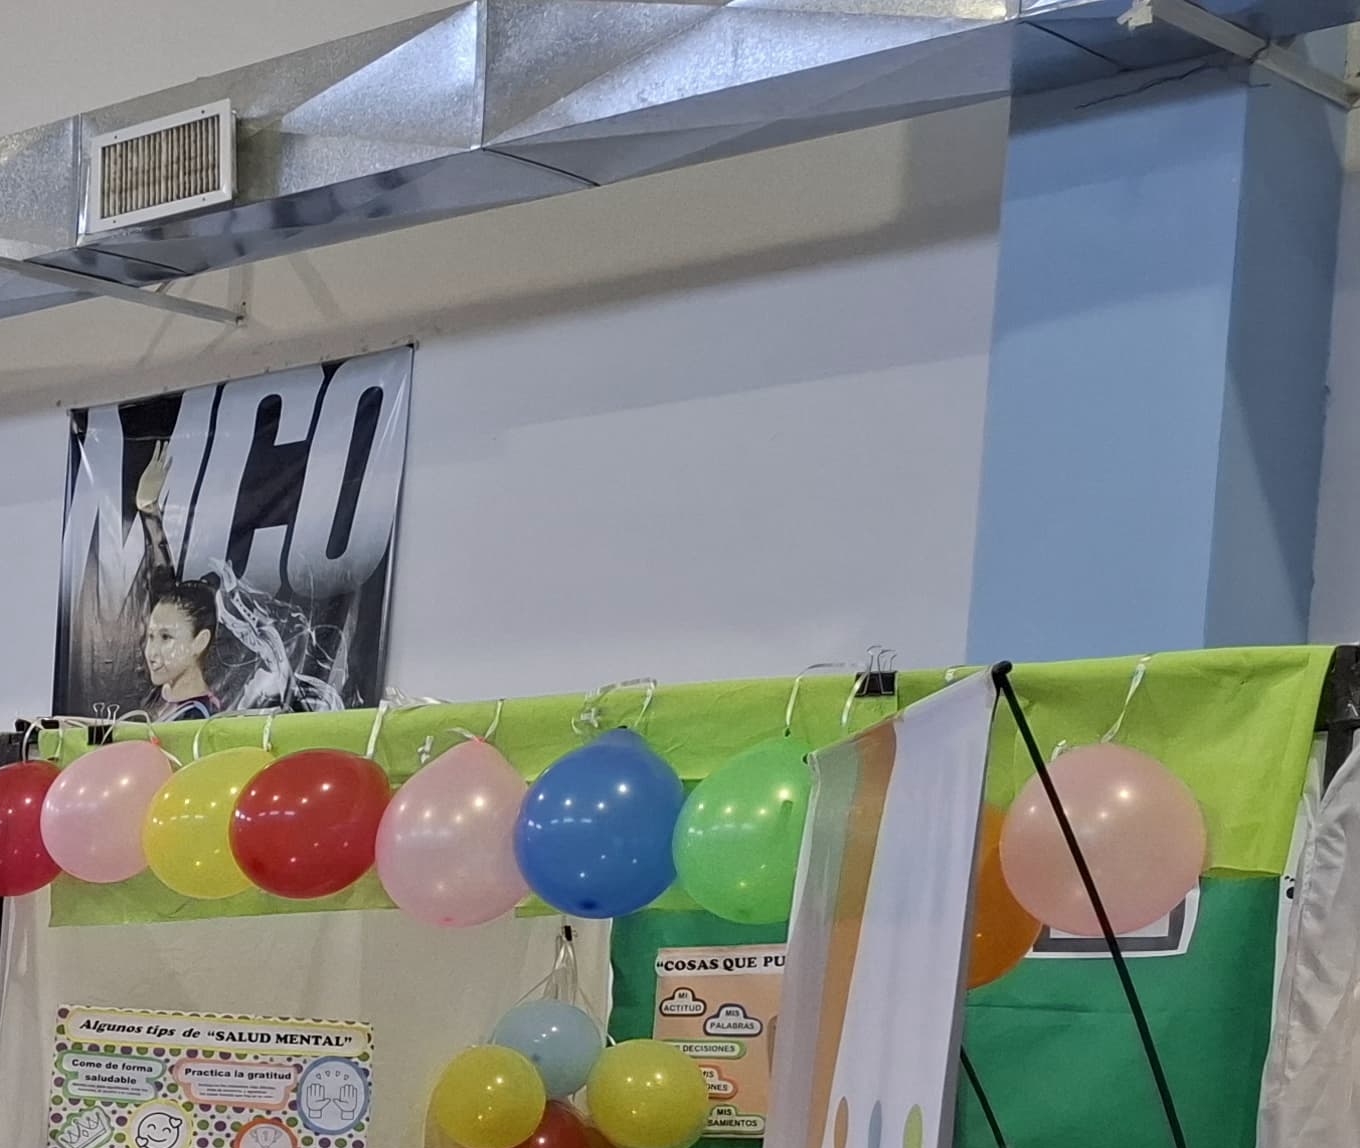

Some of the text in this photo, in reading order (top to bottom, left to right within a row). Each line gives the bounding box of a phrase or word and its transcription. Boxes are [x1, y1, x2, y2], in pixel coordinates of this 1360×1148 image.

[722, 956, 758, 972] QUE
[663, 1003, 702, 1012] ACTITUD
[725, 1009, 741, 1018] MIS
[79, 1018, 144, 1034] Algunos
[146, 1024, 177, 1038] tips
[182, 1026, 201, 1038] de
[710, 1021, 755, 1031] PALABRAS
[682, 1044, 736, 1053] DECISIONES
[71, 1058, 153, 1073] Come de forma
[84, 1072, 137, 1085] saludable
[184, 1067, 292, 1081] Practica la gratitud
[716, 1108, 733, 1116] MIS
